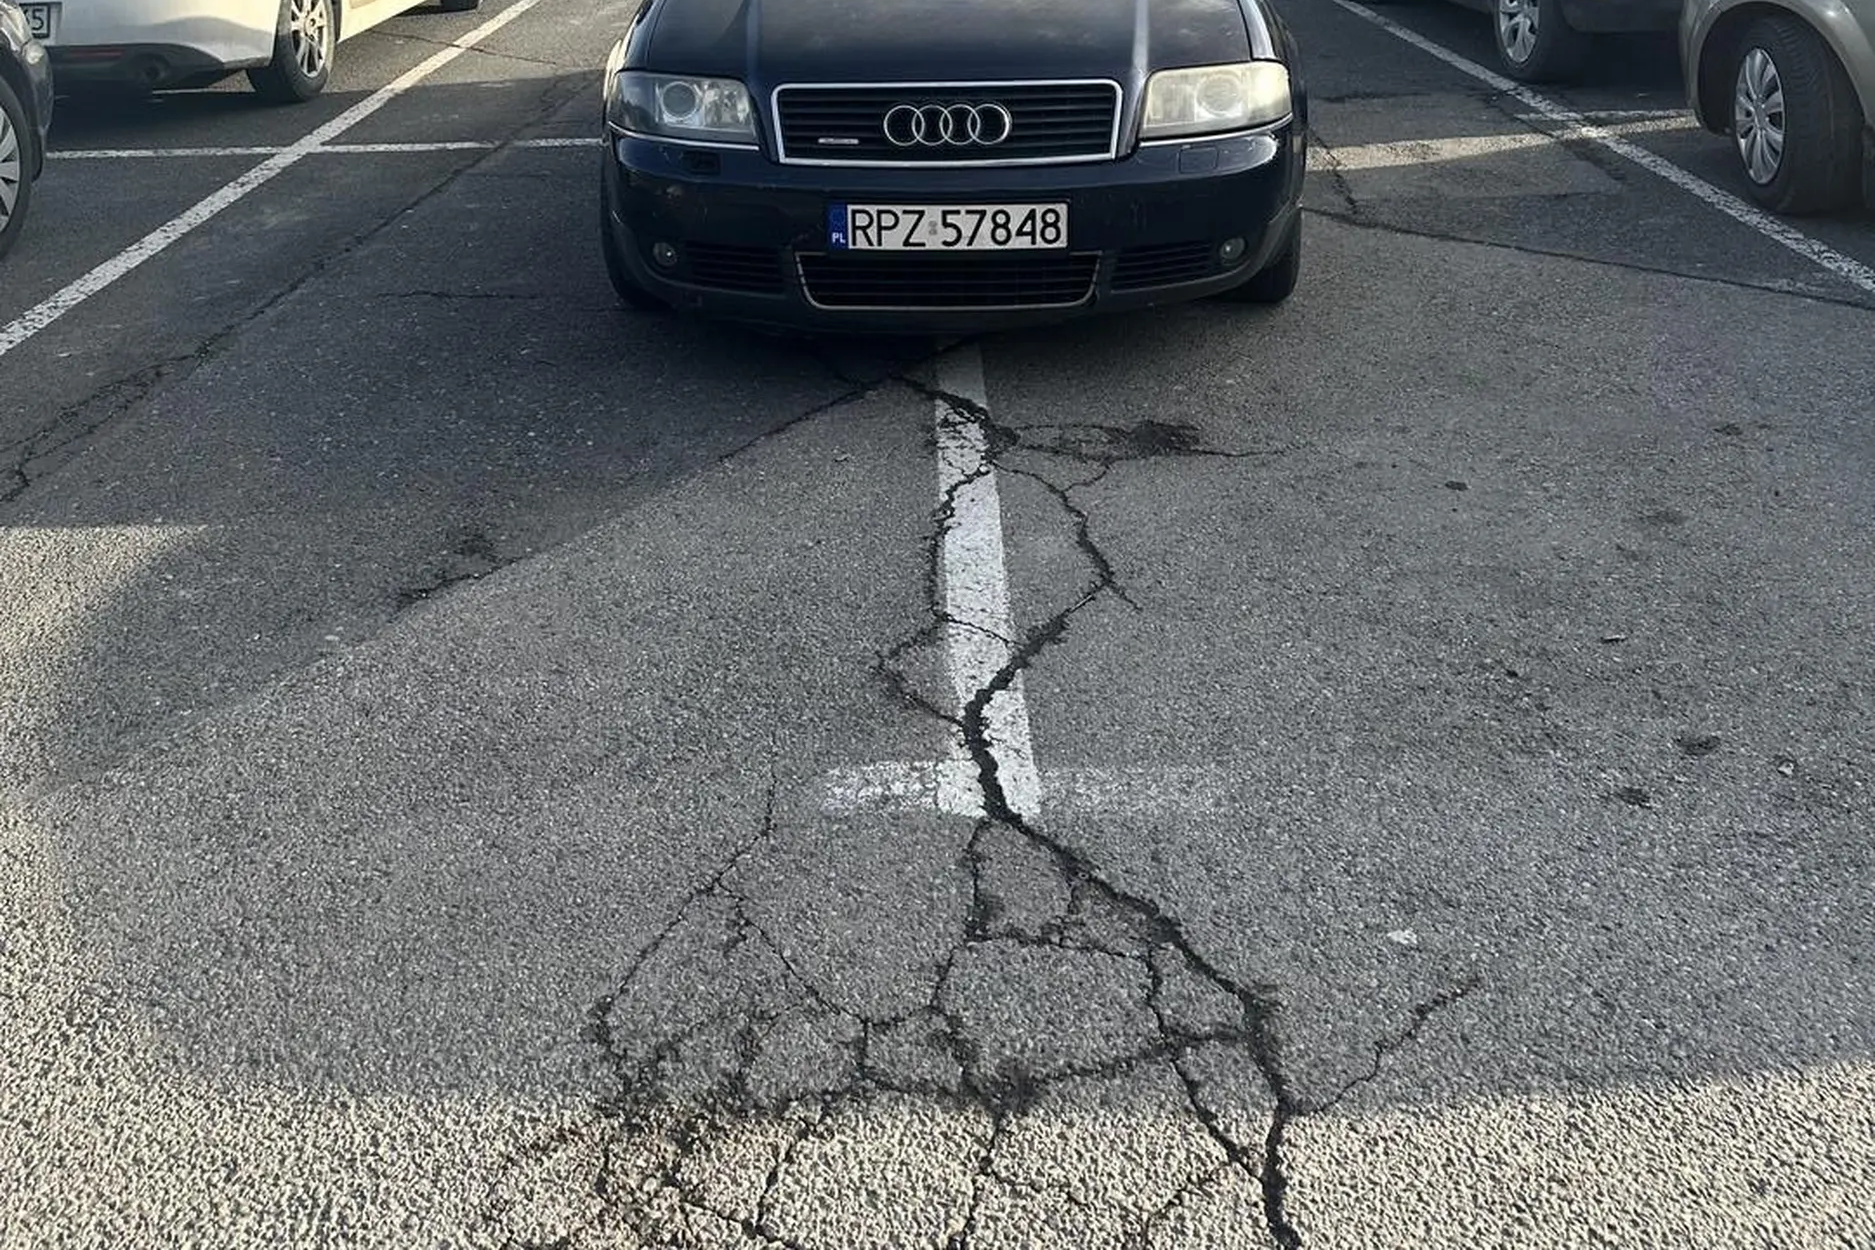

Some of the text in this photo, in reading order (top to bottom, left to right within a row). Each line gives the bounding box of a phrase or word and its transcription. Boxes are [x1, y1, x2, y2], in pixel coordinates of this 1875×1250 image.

[832, 208, 1062, 248] PL RPZ 57848
